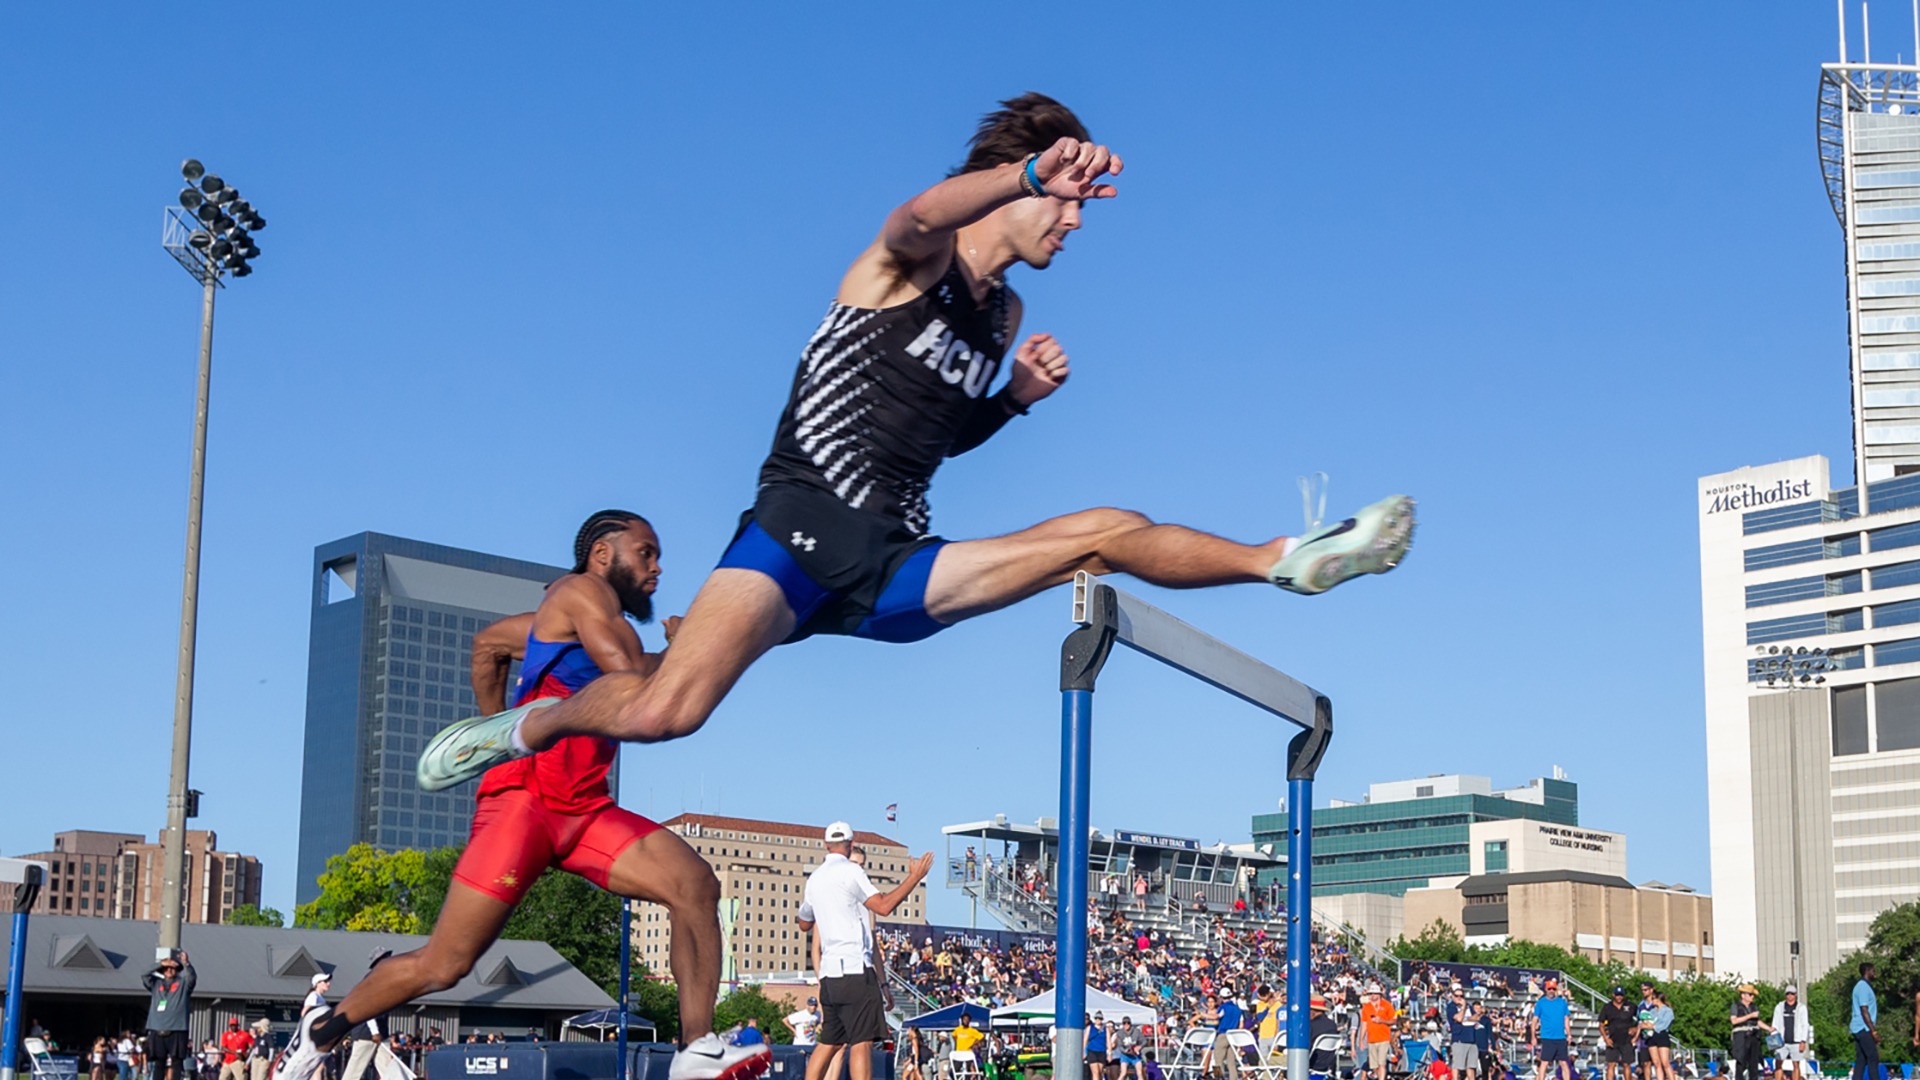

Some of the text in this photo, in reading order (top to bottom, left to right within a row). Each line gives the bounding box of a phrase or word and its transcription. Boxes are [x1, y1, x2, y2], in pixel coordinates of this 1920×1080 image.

[904, 318, 997, 399] ACU
[1706, 483, 1748, 495] HOUSTON
[1707, 479, 1812, 515] Methodist
[1560, 829, 1572, 837] VIEW
[1585, 833, 1612, 843] UNIVERSITY
[1550, 838, 1572, 848] COLLEGE
[1582, 843, 1603, 852] NURSING
[465, 1057, 497, 1069] UCS
